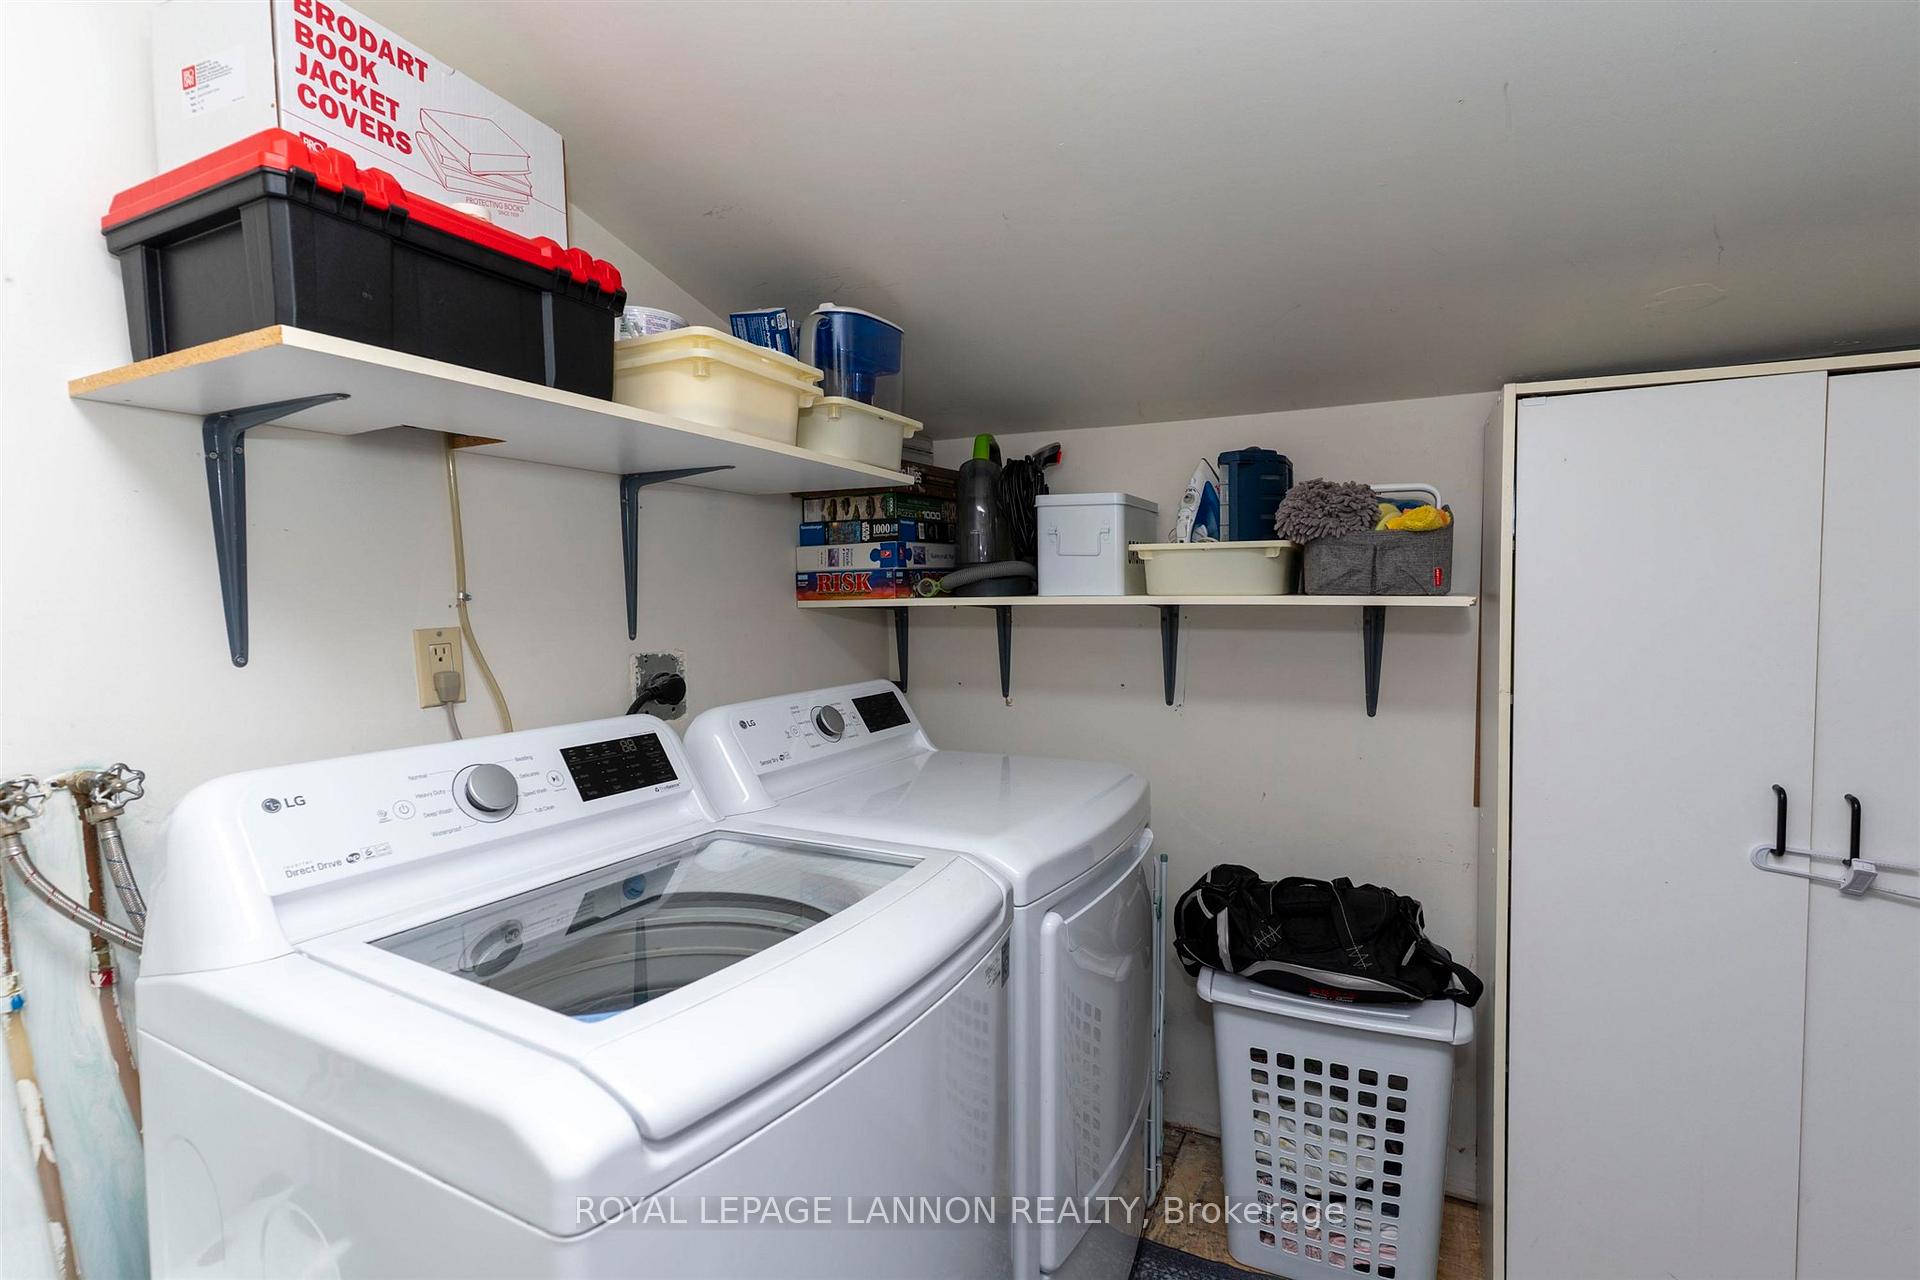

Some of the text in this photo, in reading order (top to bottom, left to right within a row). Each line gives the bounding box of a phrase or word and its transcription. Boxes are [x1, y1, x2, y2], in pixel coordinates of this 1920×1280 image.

[293, 0, 428, 82] BRODART
[295, 19, 379, 85] BOOK
[295, 52, 400, 121] JACKET
[297, 83, 412, 155] COVERS
[466, 196, 525, 213] PROTECTING BOOKS
[872, 522, 890, 535] 1000
[816, 572, 872, 592] RISK
[746, 719, 756, 727] LG
[284, 795, 306, 808] LG
[285, 859, 343, 879] Direct Drive
